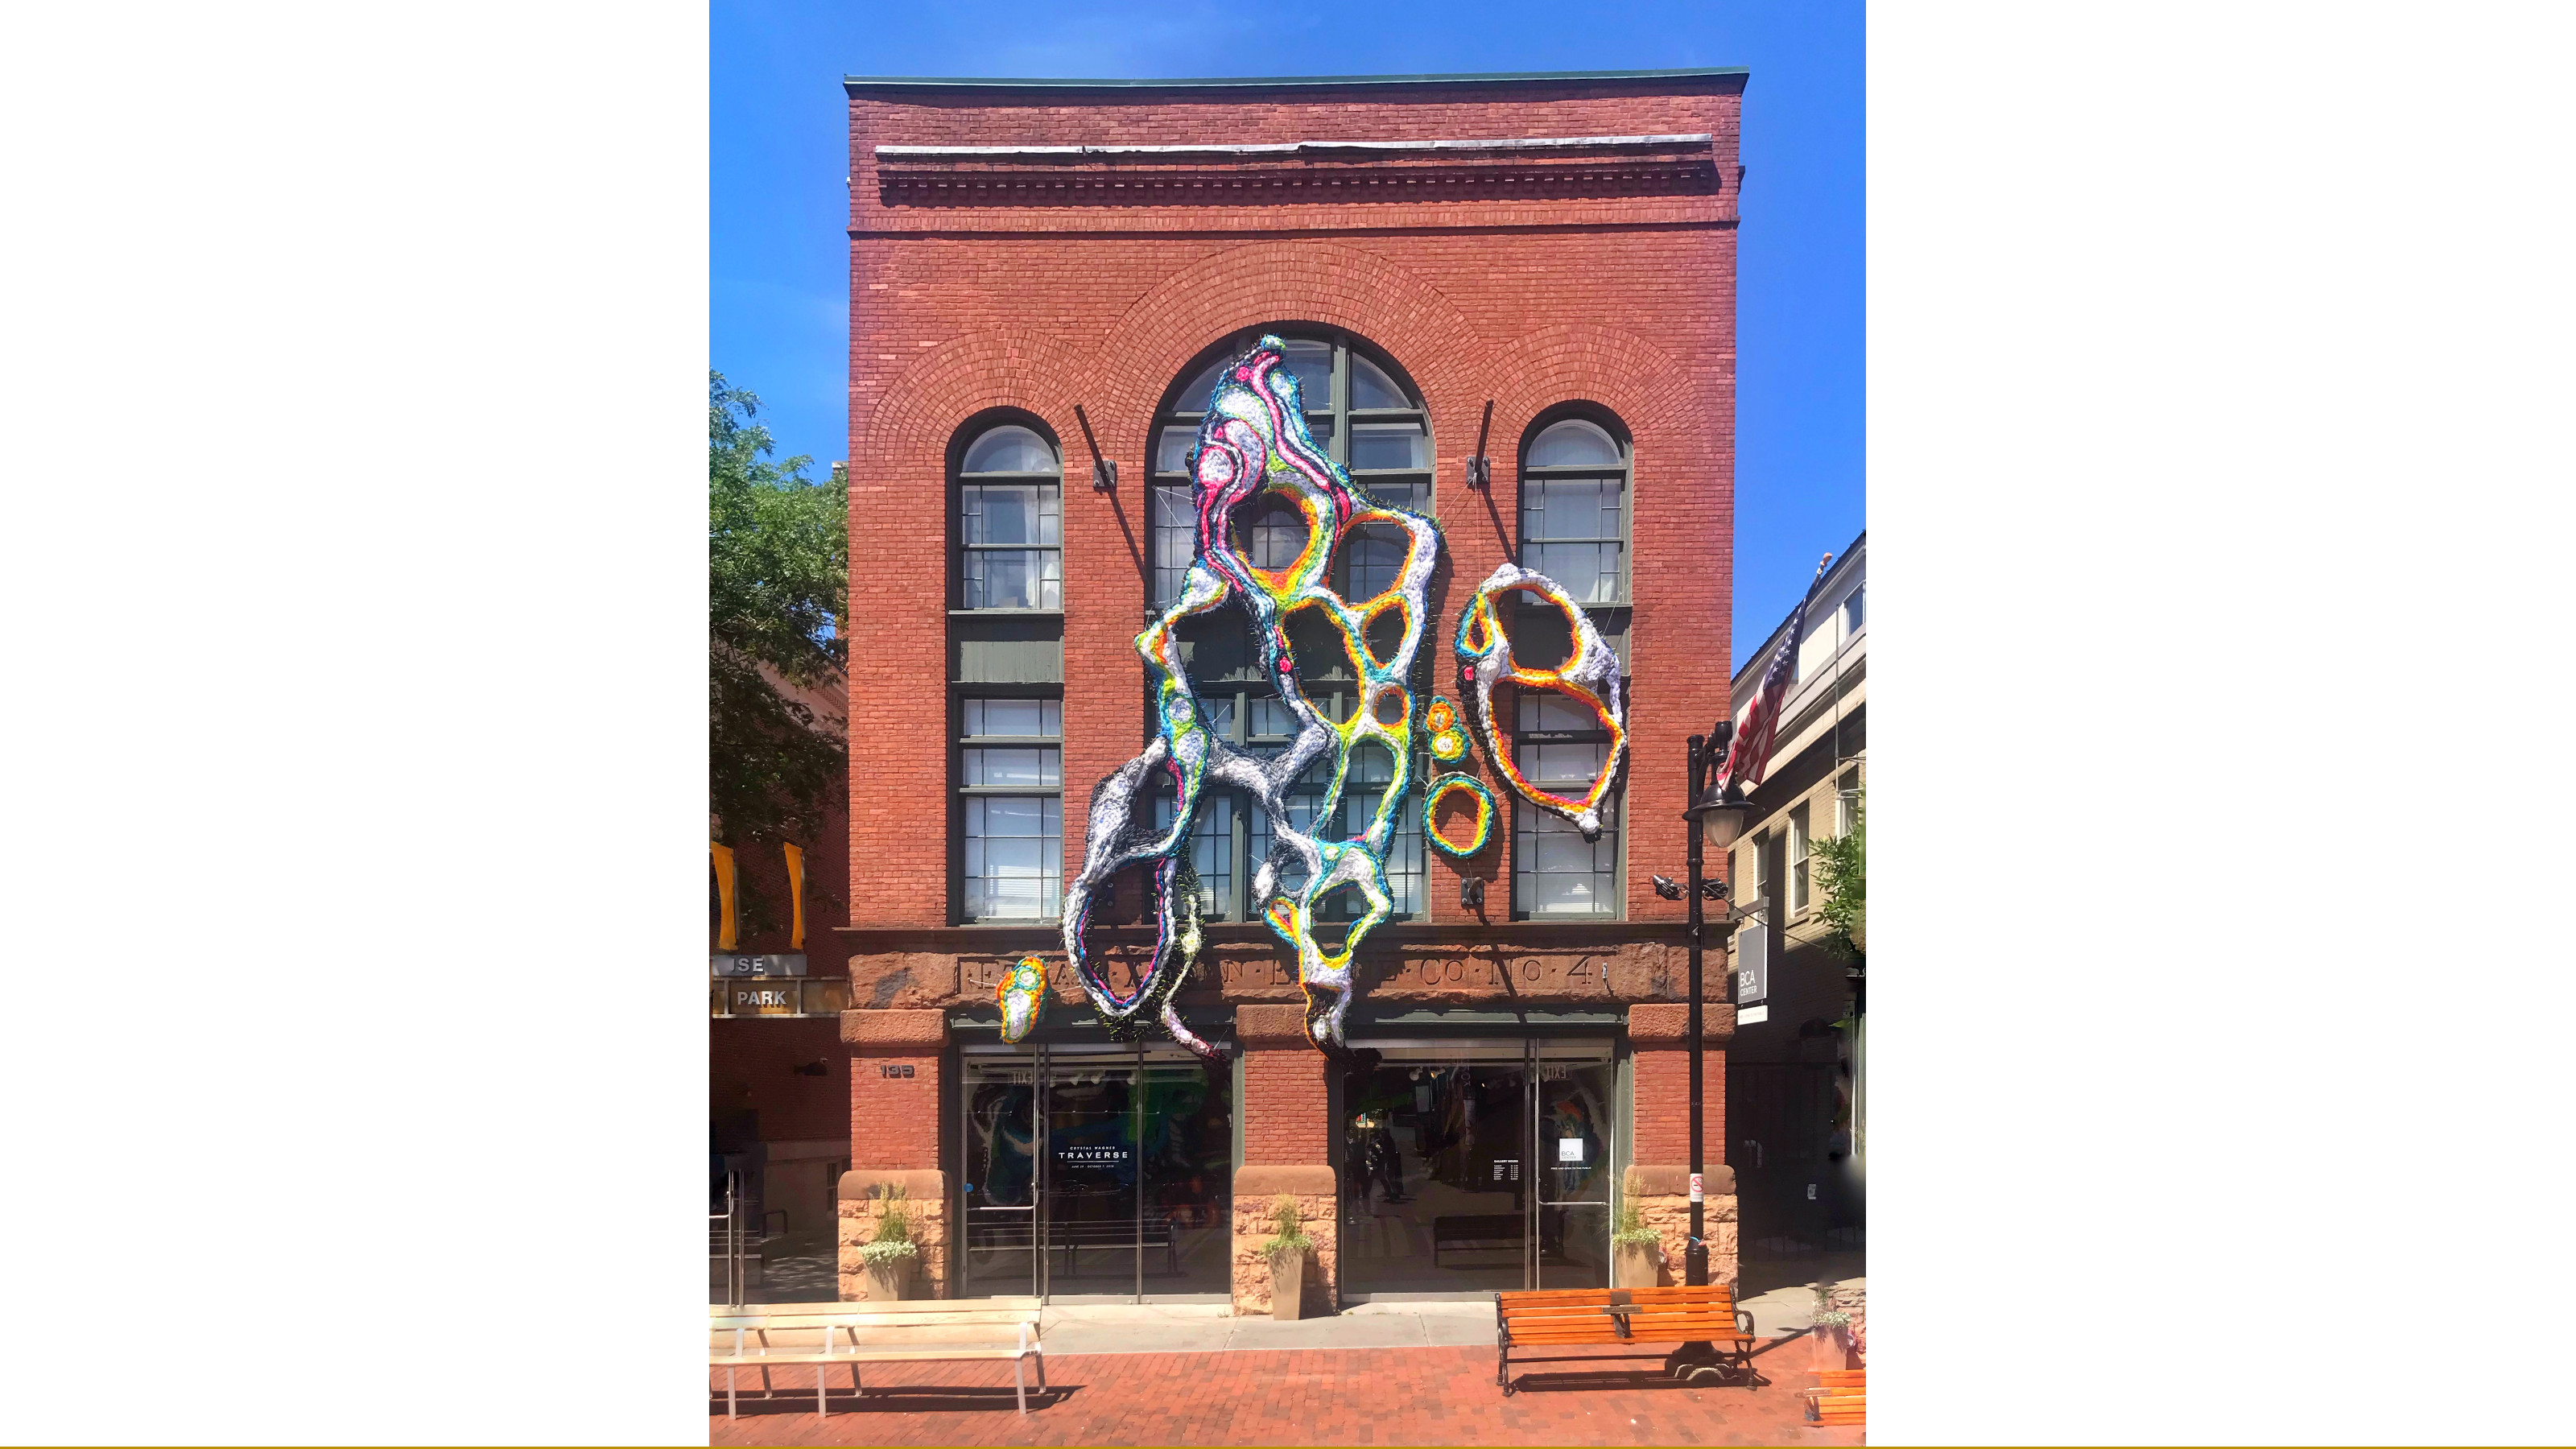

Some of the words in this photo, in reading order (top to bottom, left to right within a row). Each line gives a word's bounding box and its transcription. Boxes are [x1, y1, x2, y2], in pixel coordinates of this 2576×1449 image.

[731, 957, 764, 972] SE
[1567, 956, 1593, 985] 4
[1740, 969, 1756, 987] BCA
[737, 990, 786, 1005] PARK
[1740, 985, 1757, 997] CENTER
